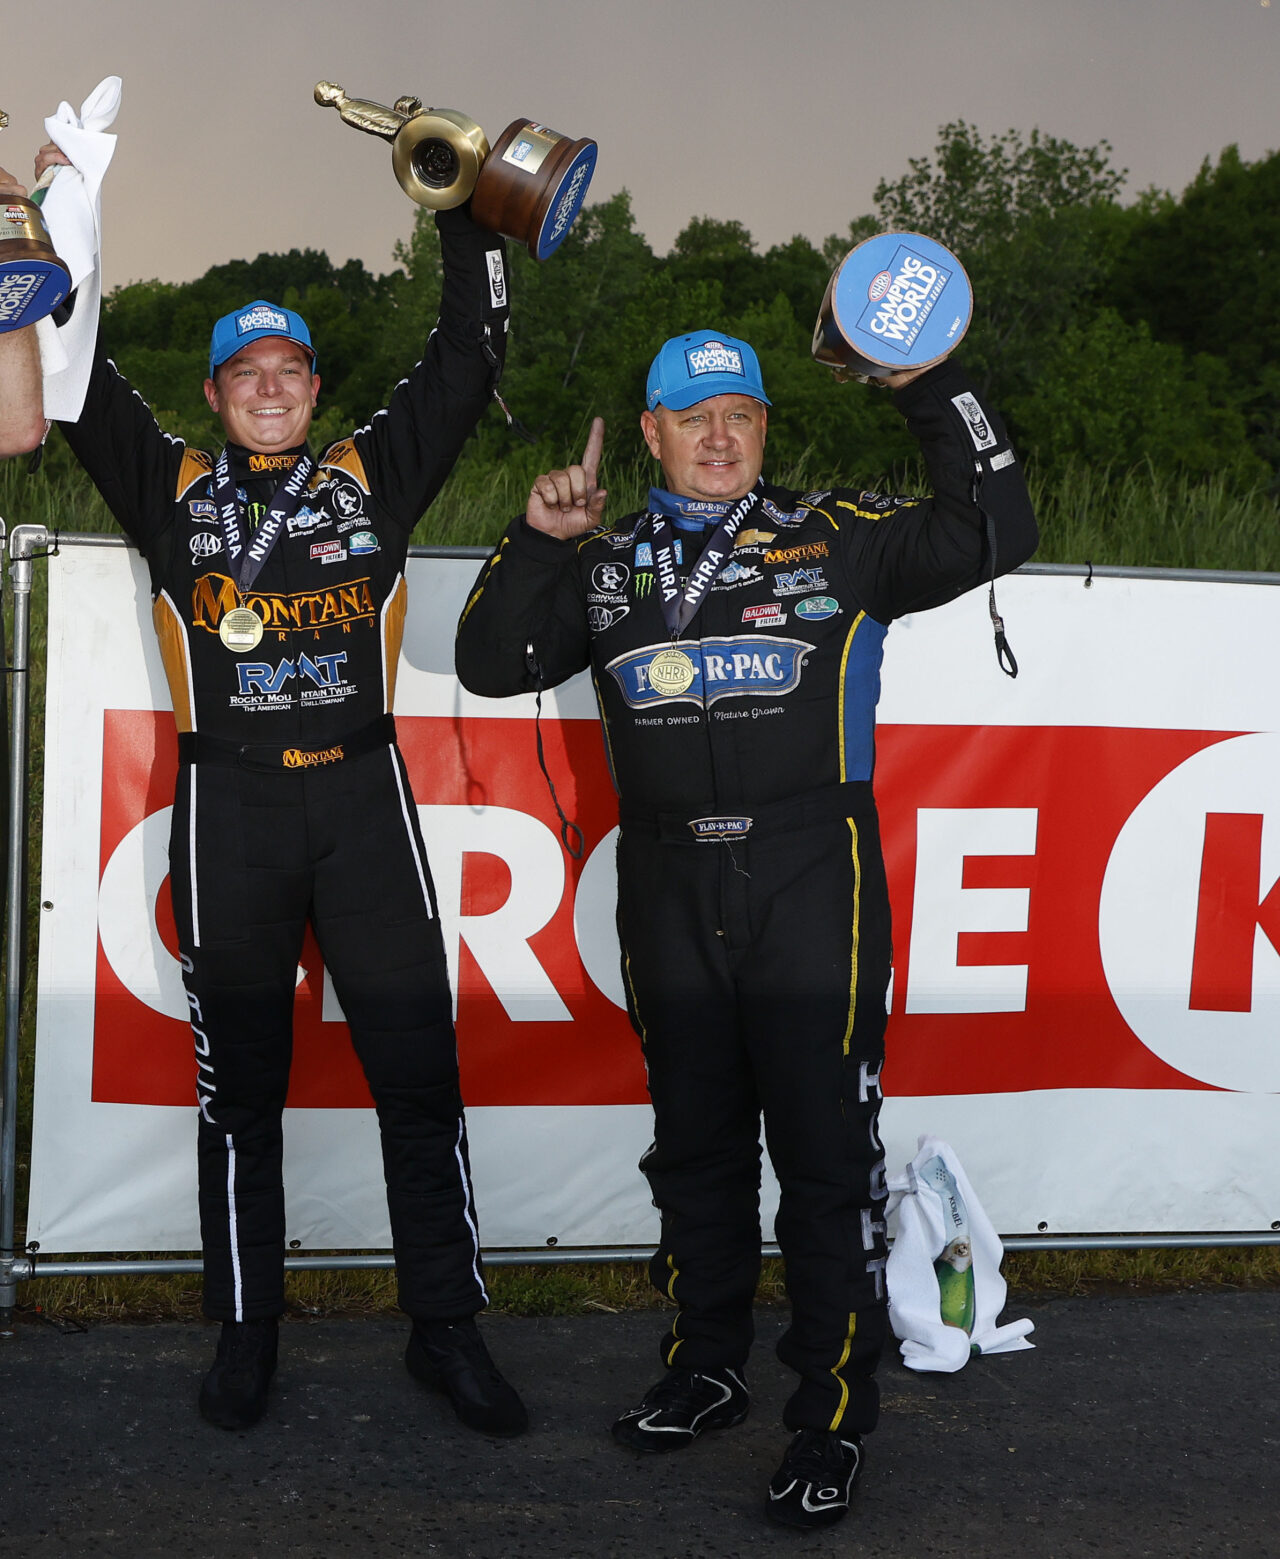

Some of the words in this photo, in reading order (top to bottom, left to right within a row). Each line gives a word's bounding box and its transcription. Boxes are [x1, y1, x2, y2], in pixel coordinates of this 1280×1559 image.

[870, 256, 922, 334] CAMPING
[883, 265, 937, 341] WORLD
[917, 300, 933, 327] RACING
[930, 275, 947, 301] SERIES
[239, 311, 286, 324] CAMPING
[240, 317, 287, 329] WORLD
[689, 349, 740, 361] CAMPING
[691, 357, 741, 370] WORLD
[284, 456, 312, 496] NHRA
[286, 506, 331, 532] PEAK
[723, 491, 758, 538] NHRA
[221, 502, 242, 560] NHRA
[248, 509, 286, 562] NHRA
[193, 533, 218, 556] AAA
[312, 543, 339, 555] BALDWIN
[764, 543, 829, 564] MONTANA
[325, 553, 344, 561] FILTERS
[656, 546, 678, 603] NHRA
[684, 550, 724, 605] NHRA
[774, 566, 823, 589] RMT
[192, 573, 376, 632] MONTANA
[744, 606, 780, 618] BALDWIN
[760, 617, 783, 625] FILTERS
[236, 651, 348, 695] RMT
[657, 665, 686, 680] NHRA
[230, 695, 264, 704] ROCKY
[328, 684, 357, 696] TWIST
[243, 704, 256, 712] THE
[257, 703, 291, 712] AMERICAN
[635, 718, 663, 726] FARMER
[667, 715, 700, 725] OWNED
[714, 710, 749, 721] Nature
[751, 706, 784, 720] Grown
[283, 746, 344, 768] MONTANA
[948, 1196, 963, 1228] KORBEL
